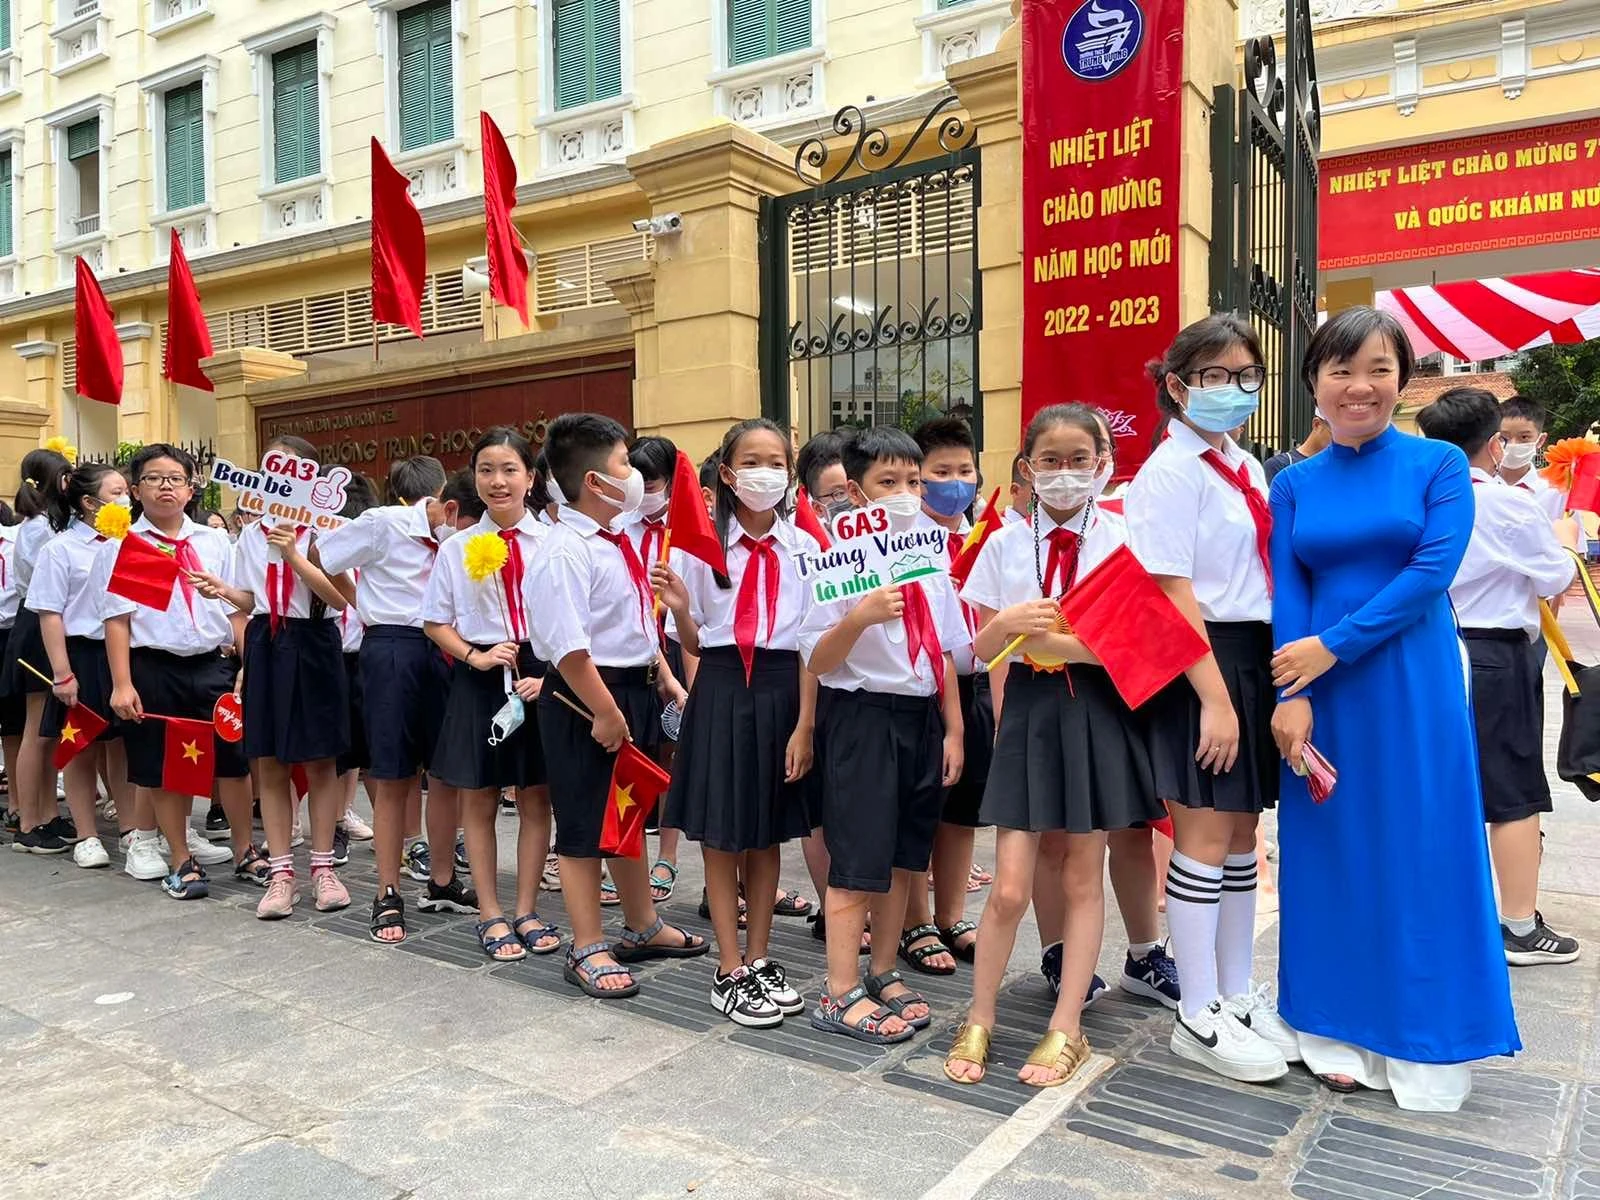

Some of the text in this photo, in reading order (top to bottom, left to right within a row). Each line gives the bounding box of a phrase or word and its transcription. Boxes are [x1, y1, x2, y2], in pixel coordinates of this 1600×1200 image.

[1050, 116, 1153, 168] NHIỆT LIỆT
[1329, 138, 1600, 194] NHIỆT LIỆT CHÀO MỪNG 7
[1043, 176, 1161, 226] CHÀO MỪNG
[1394, 206, 1421, 230] VÀ
[1428, 195, 1483, 228] QUỐC
[1489, 191, 1564, 218] KHÁNH
[1033, 228, 1171, 283] NĂM HỌC MỚI
[1044, 296, 1160, 337] 2022 - 2023
[385, 432, 436, 461] TRUNG
[440, 426, 482, 457] HỌC
[214, 462, 293, 497] Bạn bè
[265, 454, 315, 481] 6A3
[241, 491, 264, 511] là
[268, 502, 312, 524] anh
[837, 508, 889, 540] 6A3
[793, 528, 946, 577] Trưng Vương
[815, 570, 883, 601] là nhà
[1142, 970, 1167, 989] N
